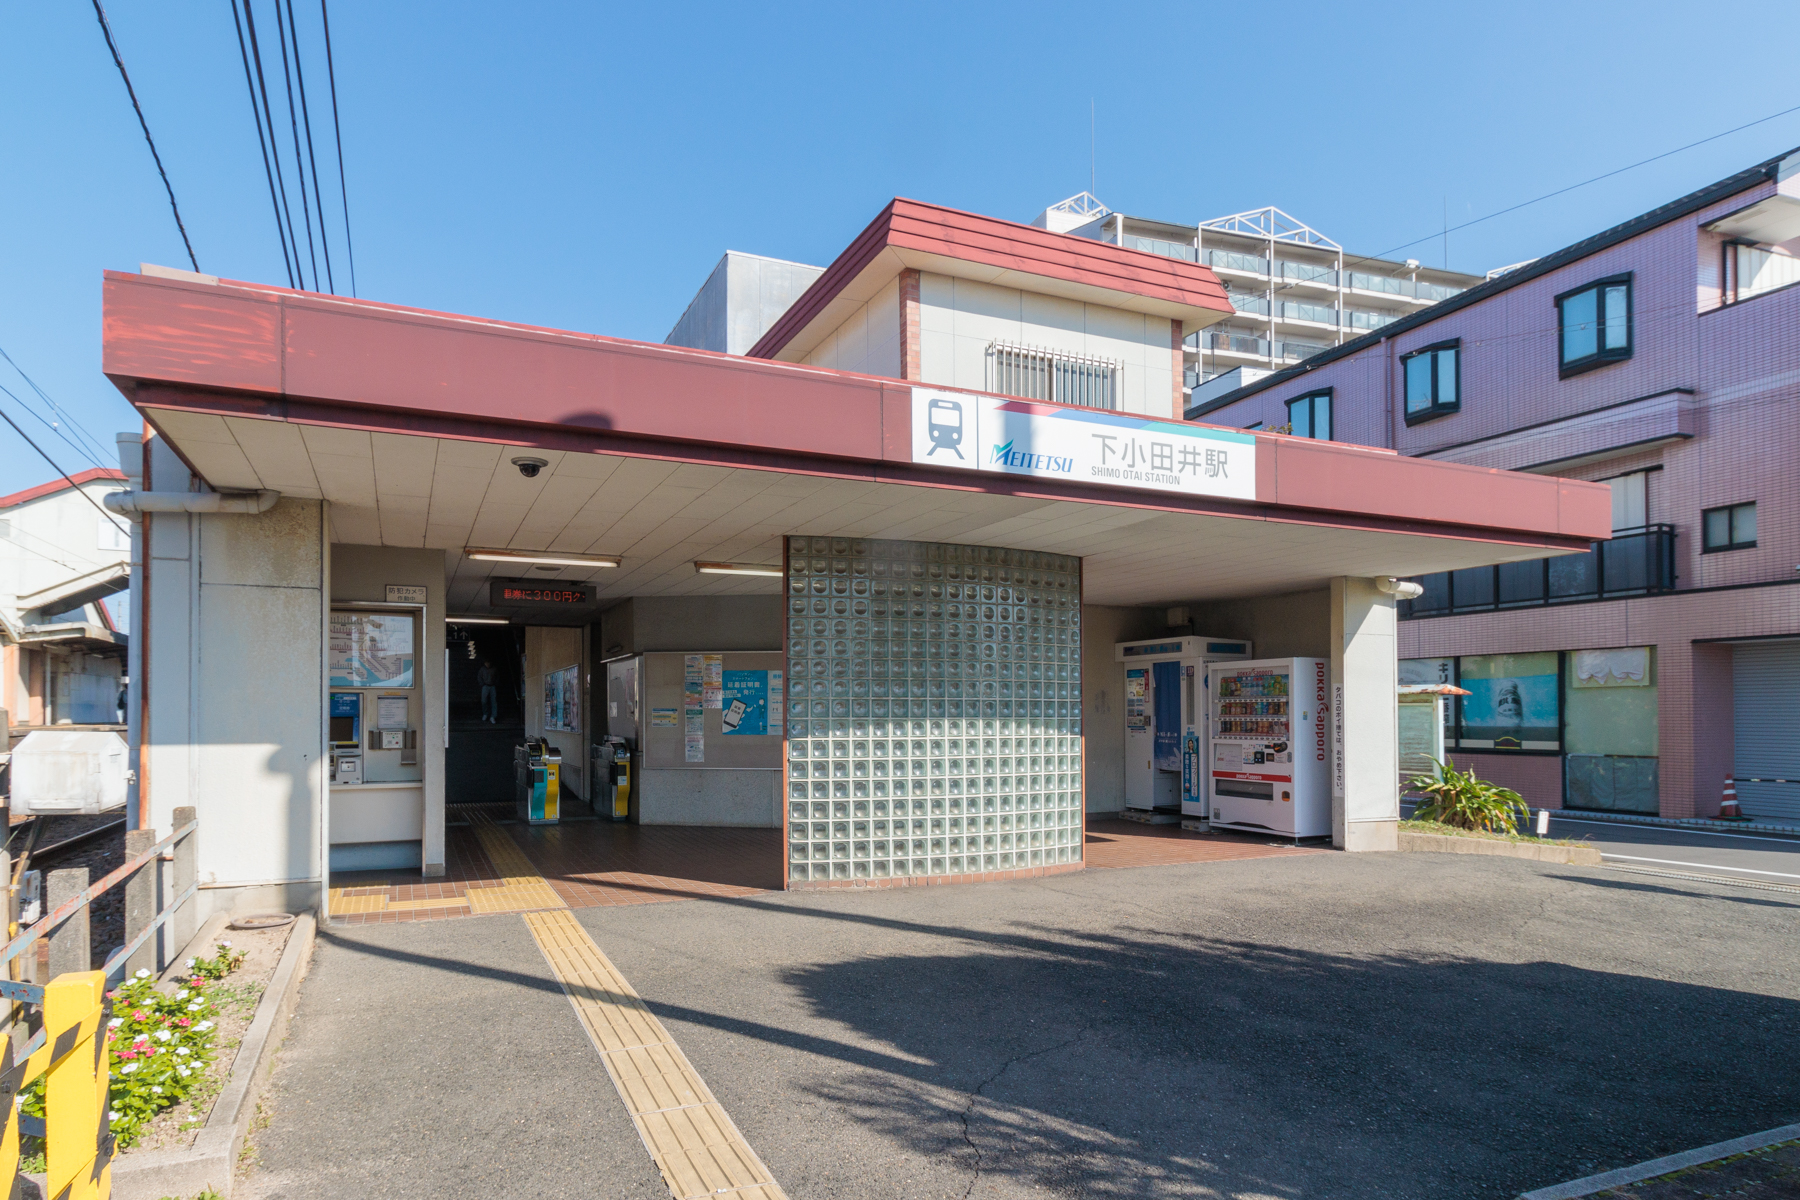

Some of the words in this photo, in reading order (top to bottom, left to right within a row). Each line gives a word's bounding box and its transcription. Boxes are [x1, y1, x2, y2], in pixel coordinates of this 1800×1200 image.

[989, 438, 1073, 473] MEITETSU
[1091, 433, 1229, 479] 下小田井駅
[1091, 466, 1121, 479] SHIMO
[1122, 469, 1143, 481] OTAI
[1144, 472, 1181, 485] STATION
[388, 587, 425, 595] 防犯カメラ
[1315, 662, 1325, 701] pokka
[1315, 702, 1329, 761] sapporo
